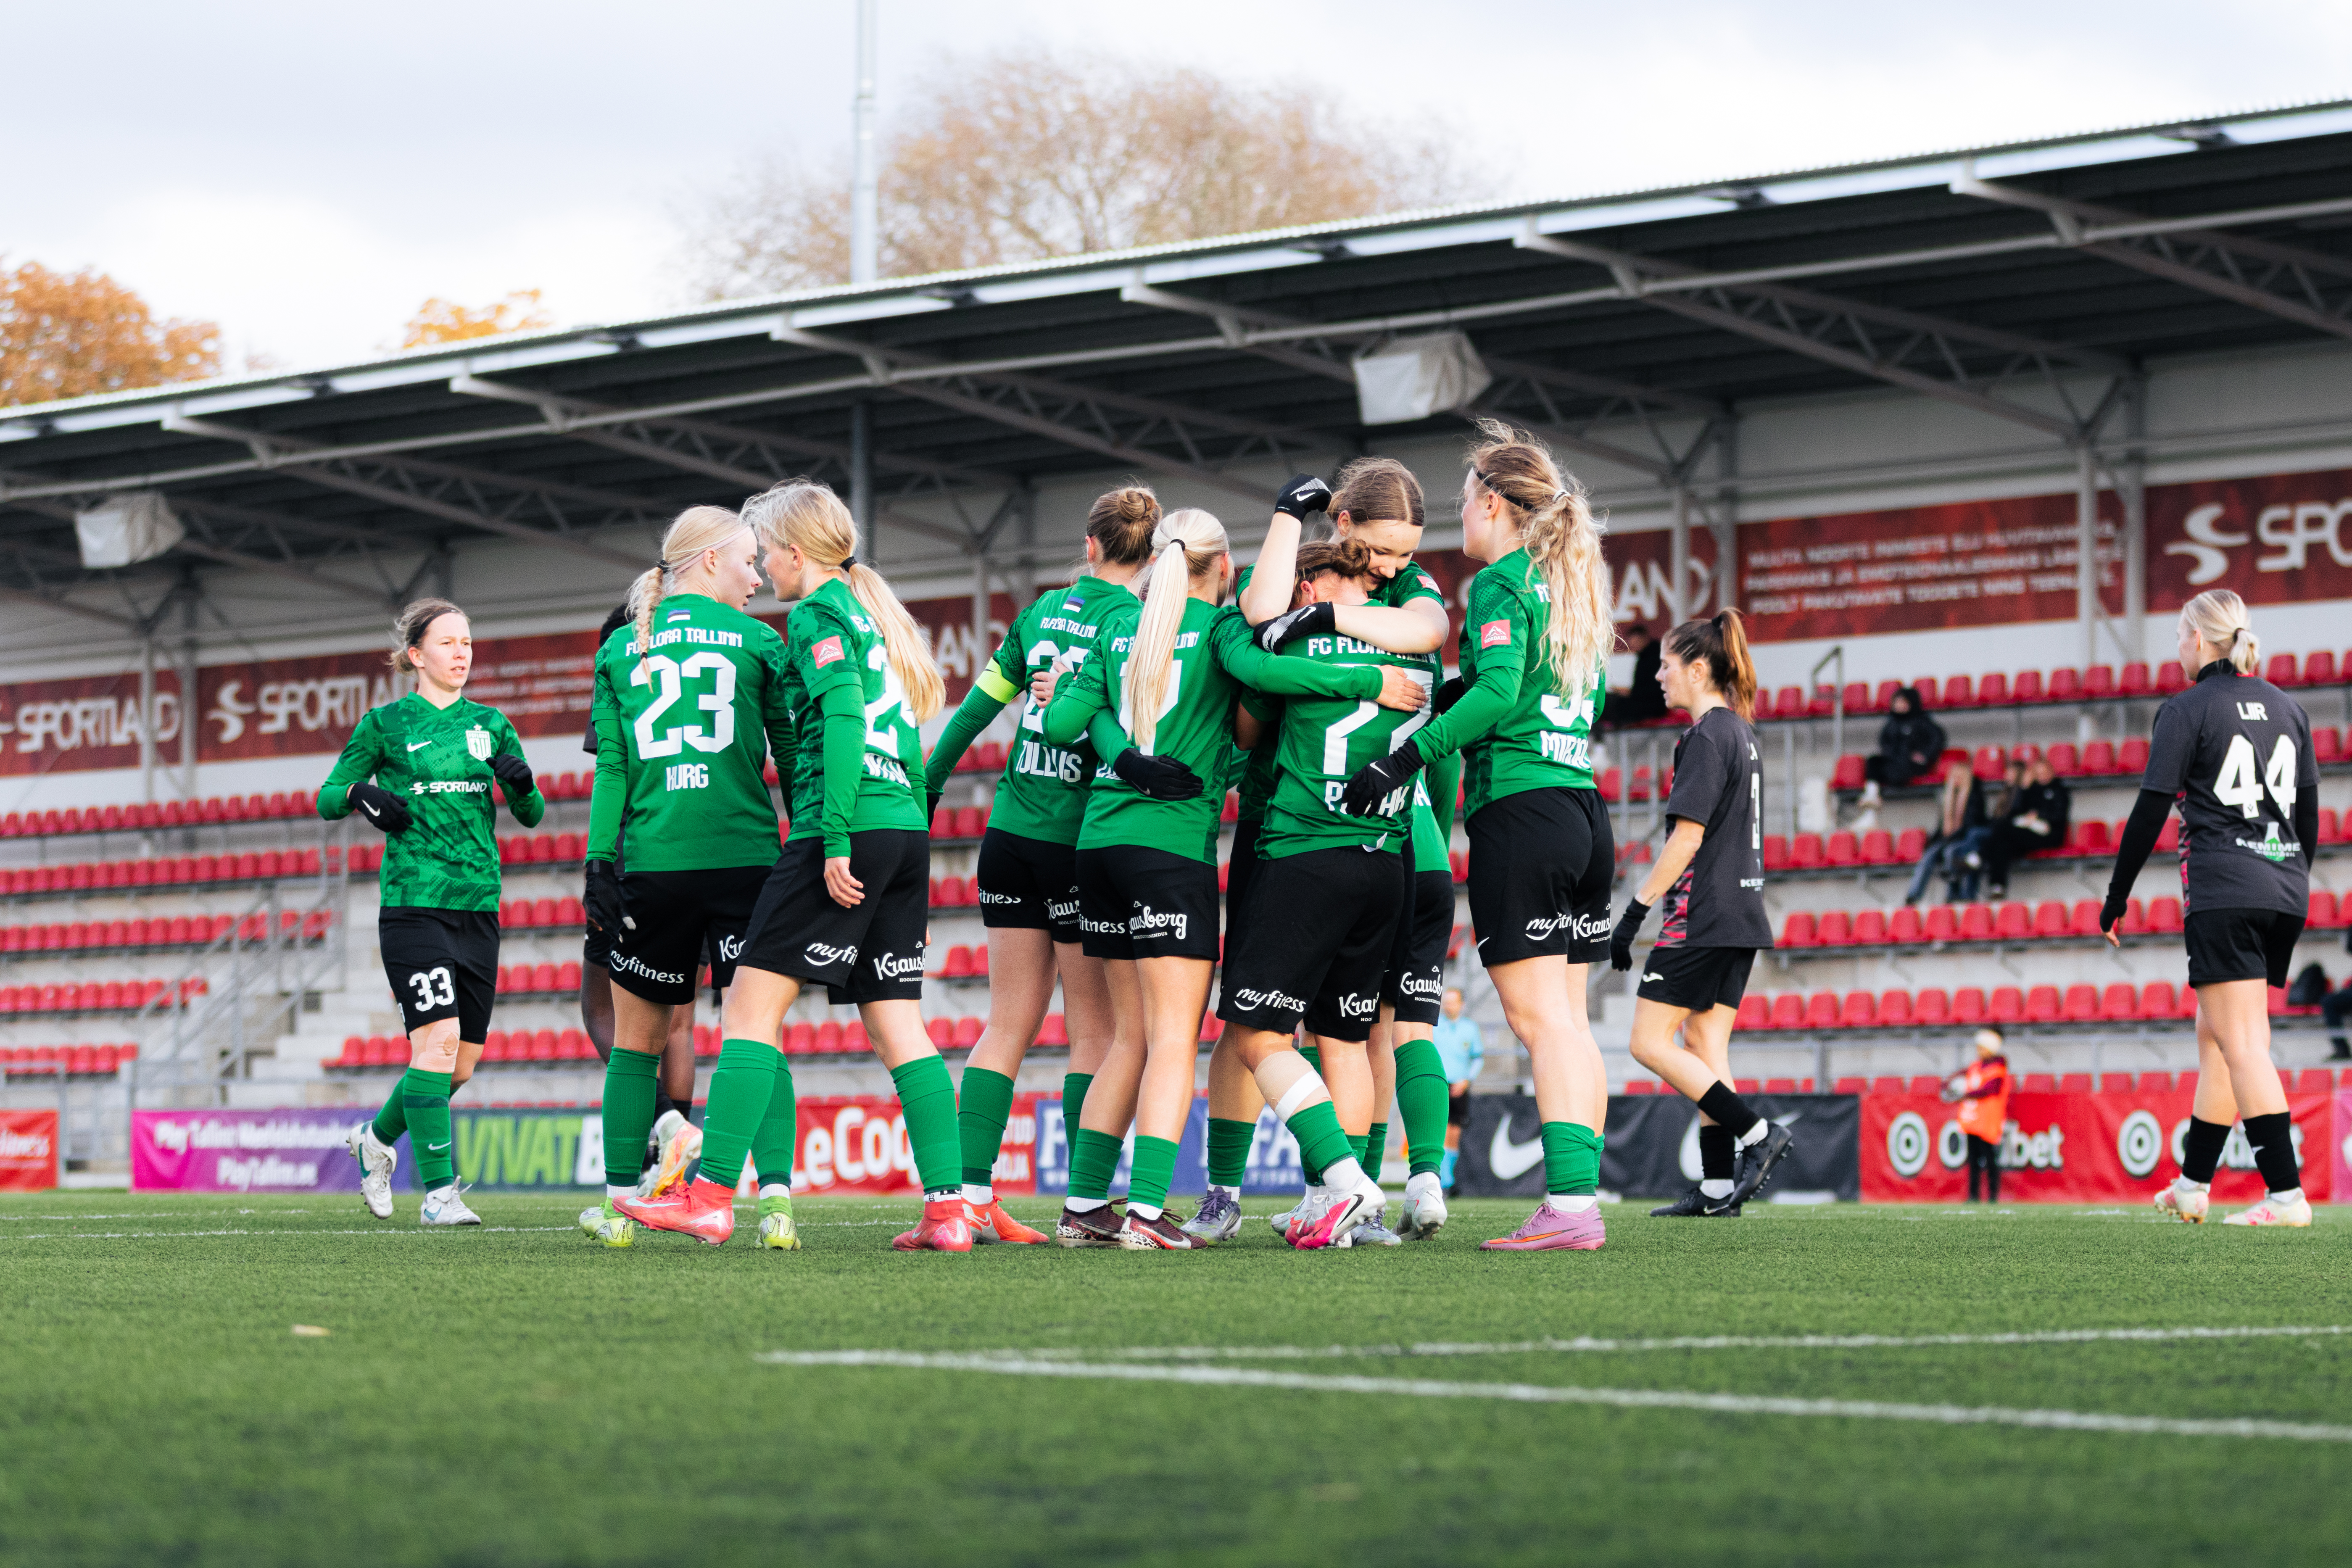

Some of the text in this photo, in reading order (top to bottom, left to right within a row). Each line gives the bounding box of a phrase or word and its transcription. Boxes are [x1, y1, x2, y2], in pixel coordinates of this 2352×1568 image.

[685, 627, 742, 648] TALLINN
[1111, 637, 1129, 652] FC
[1308, 638, 1332, 656] FC
[1484, 635, 1507, 644] NORDAID
[818, 651, 841, 664] NORDAID
[630, 652, 737, 760] 23
[2236, 702, 2268, 721] LIIR
[666, 763, 709, 791] KURG
[2213, 734, 2297, 819] 44
[429, 781, 487, 793] SPORTLAND
[610, 949, 685, 984] myfitness
[409, 967, 455, 1012] 33
